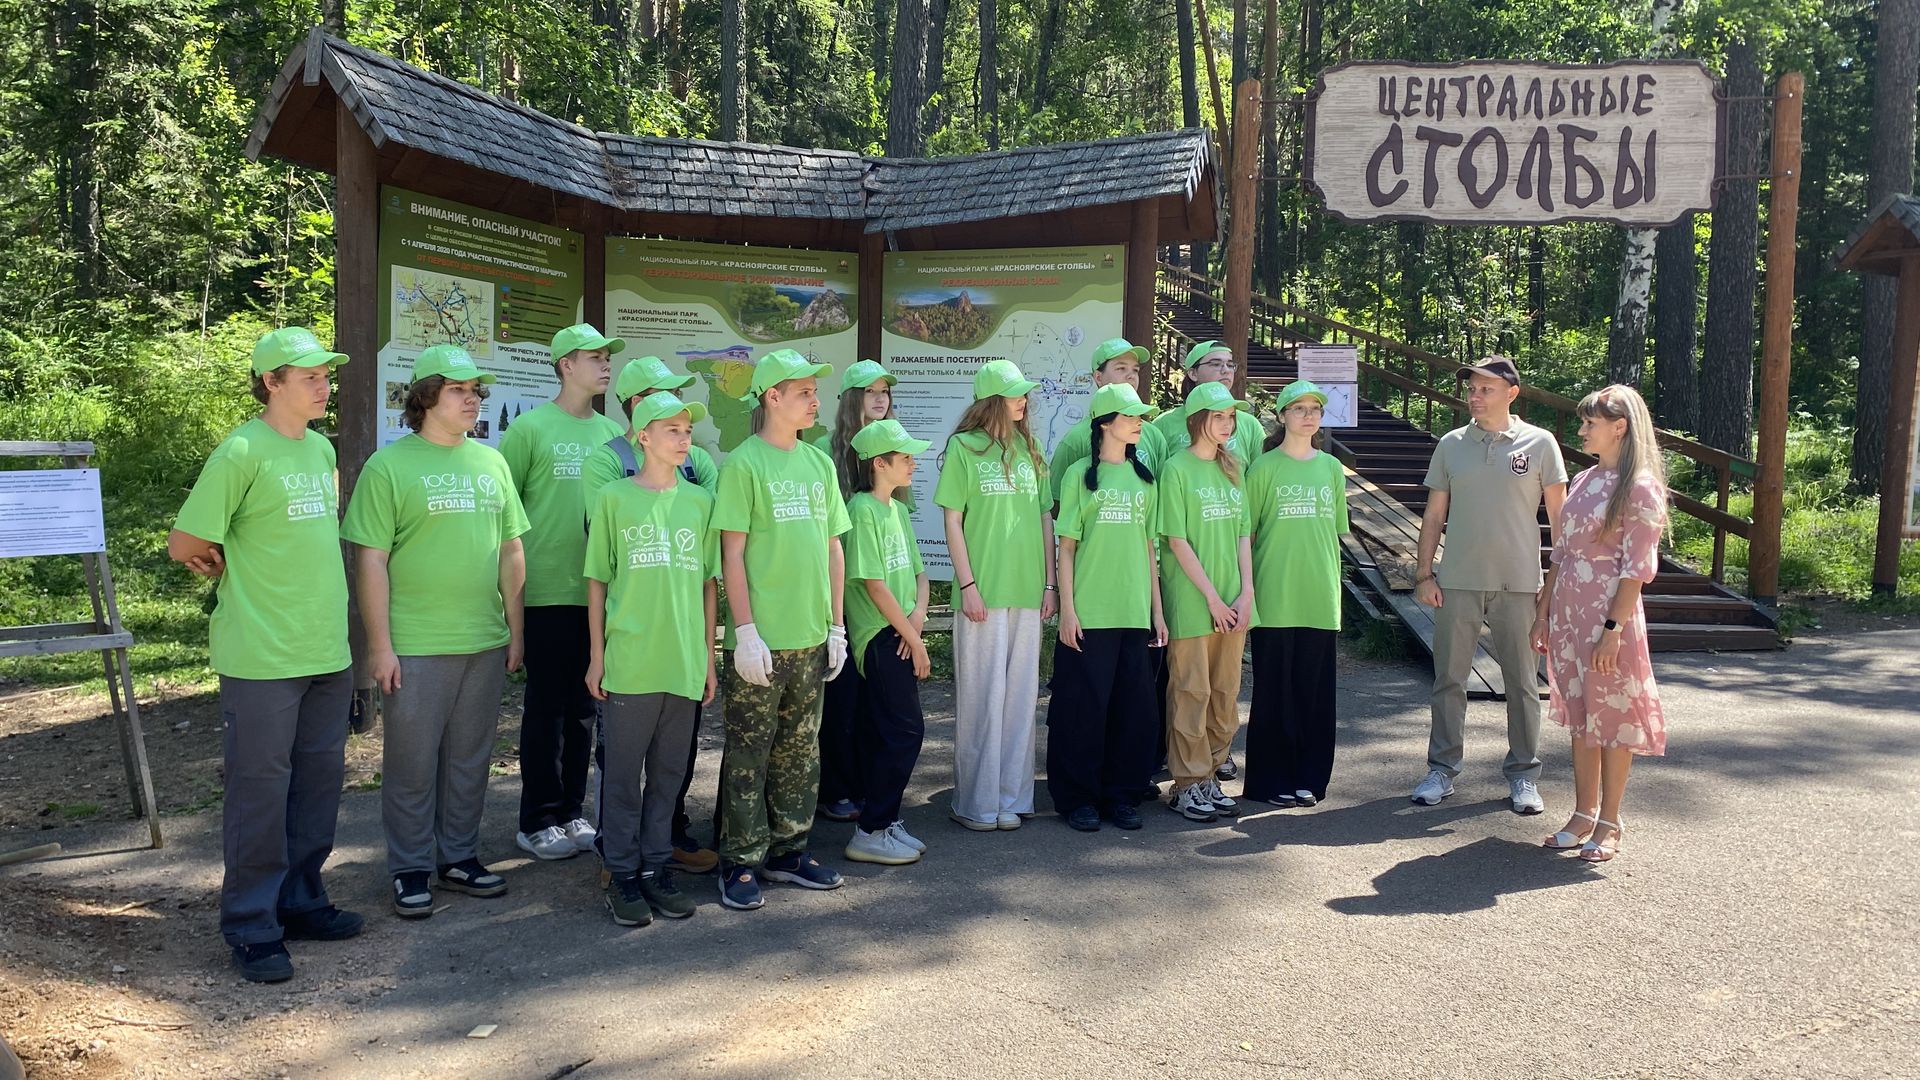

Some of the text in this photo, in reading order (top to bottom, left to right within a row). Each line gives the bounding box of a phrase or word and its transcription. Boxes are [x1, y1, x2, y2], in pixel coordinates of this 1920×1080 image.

[1378, 73, 1657, 122] ЦЕНТРАЛЬНЫЕ
[1365, 122, 1657, 213] СТОЛБЫ
[410, 202, 562, 247] ВНИМАНИЕ, ОПАСНЫЙ УЧАСТОК!
[412, 240, 436, 252] АПРЕЛЯ
[436, 245, 450, 255] 2020
[451, 248, 467, 258] ГОДА
[467, 252, 493, 263] УЧАСТОК
[493, 257, 540, 273] ТУРИСТИЧЕСКОГО
[540, 266, 568, 278] МАРШРУТА
[640, 256, 827, 273] НАЦИОНАЛЬНЫЙ ПАРК «КРАСНОЯРСКИЕ СТОЛБЫ»
[918, 265, 971, 274] НАЦИОНАЛЬНЫЙ
[991, 263, 1056, 272] «КРАСНОЯРСКИЕ
[1057, 262, 1096, 270] СТОЛБЫ»
[749, 274, 825, 287] ЗОНИРОВАНИЕ
[617, 308, 678, 317] НАЦИОНАЛЬНЫЙ
[618, 315, 713, 326] «КРАСНОЯРСКИЕ СТОЛБЫ»
[890, 356, 944, 364] УВАЖАЕМЫЕ
[553, 466, 581, 476] СТОЛ
[428, 499, 476, 512] СТОЛБЫ
[1098, 511, 1132, 520] ТОЛБЫ
[916, 538, 947, 546] СТАЛЬНА
[629, 552, 671, 564] ТОЛБЫ
